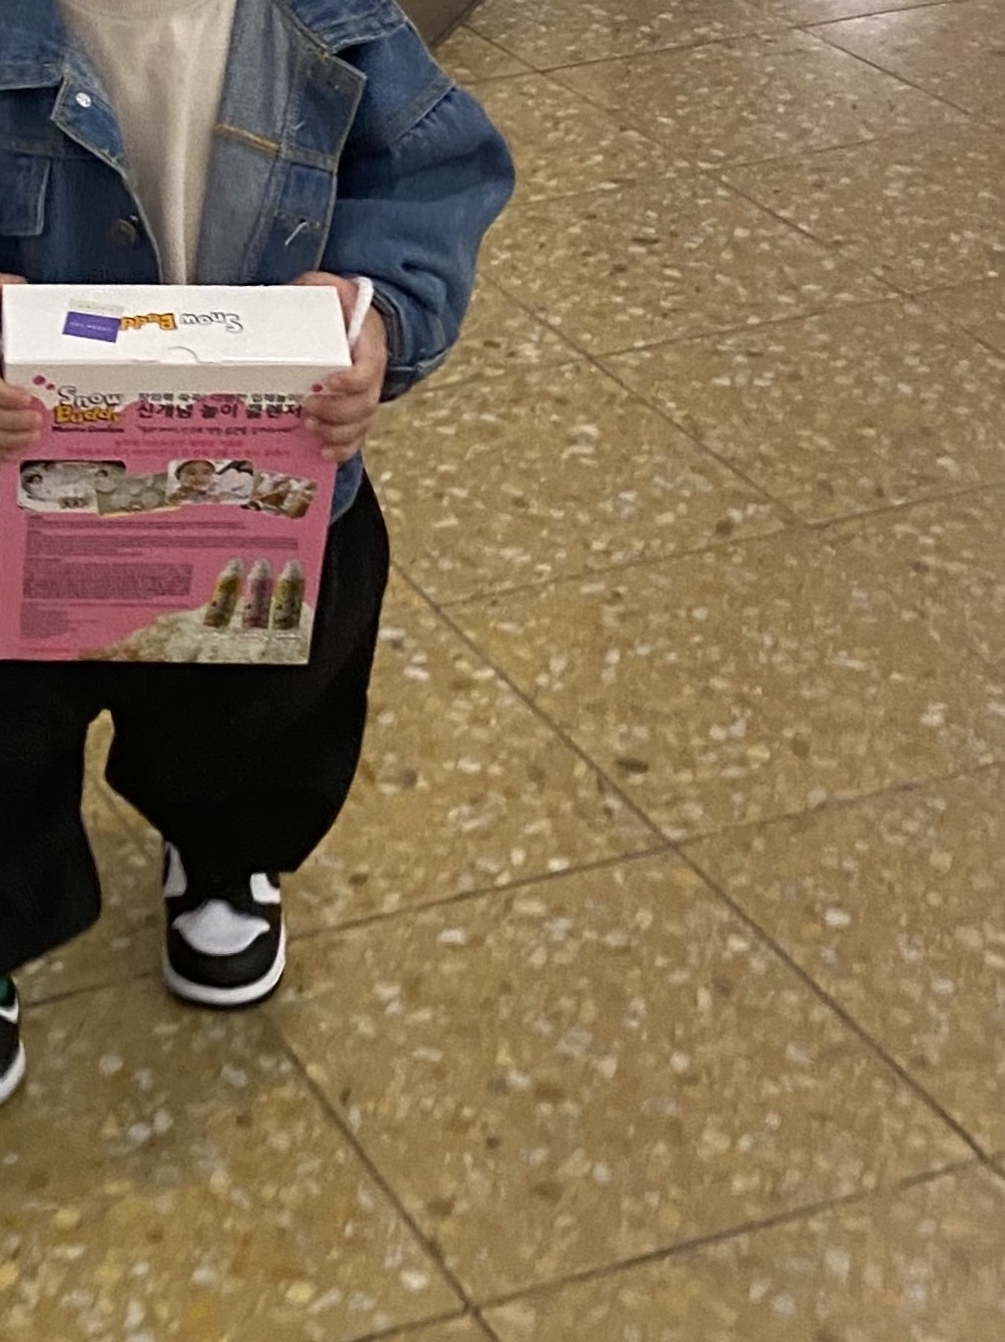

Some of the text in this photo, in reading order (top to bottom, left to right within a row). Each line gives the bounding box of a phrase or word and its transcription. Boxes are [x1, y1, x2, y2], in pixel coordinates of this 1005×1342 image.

[118, 312, 178, 331] Budd
[180, 311, 244, 334] Snow
[57, 385, 124, 408] Snow
